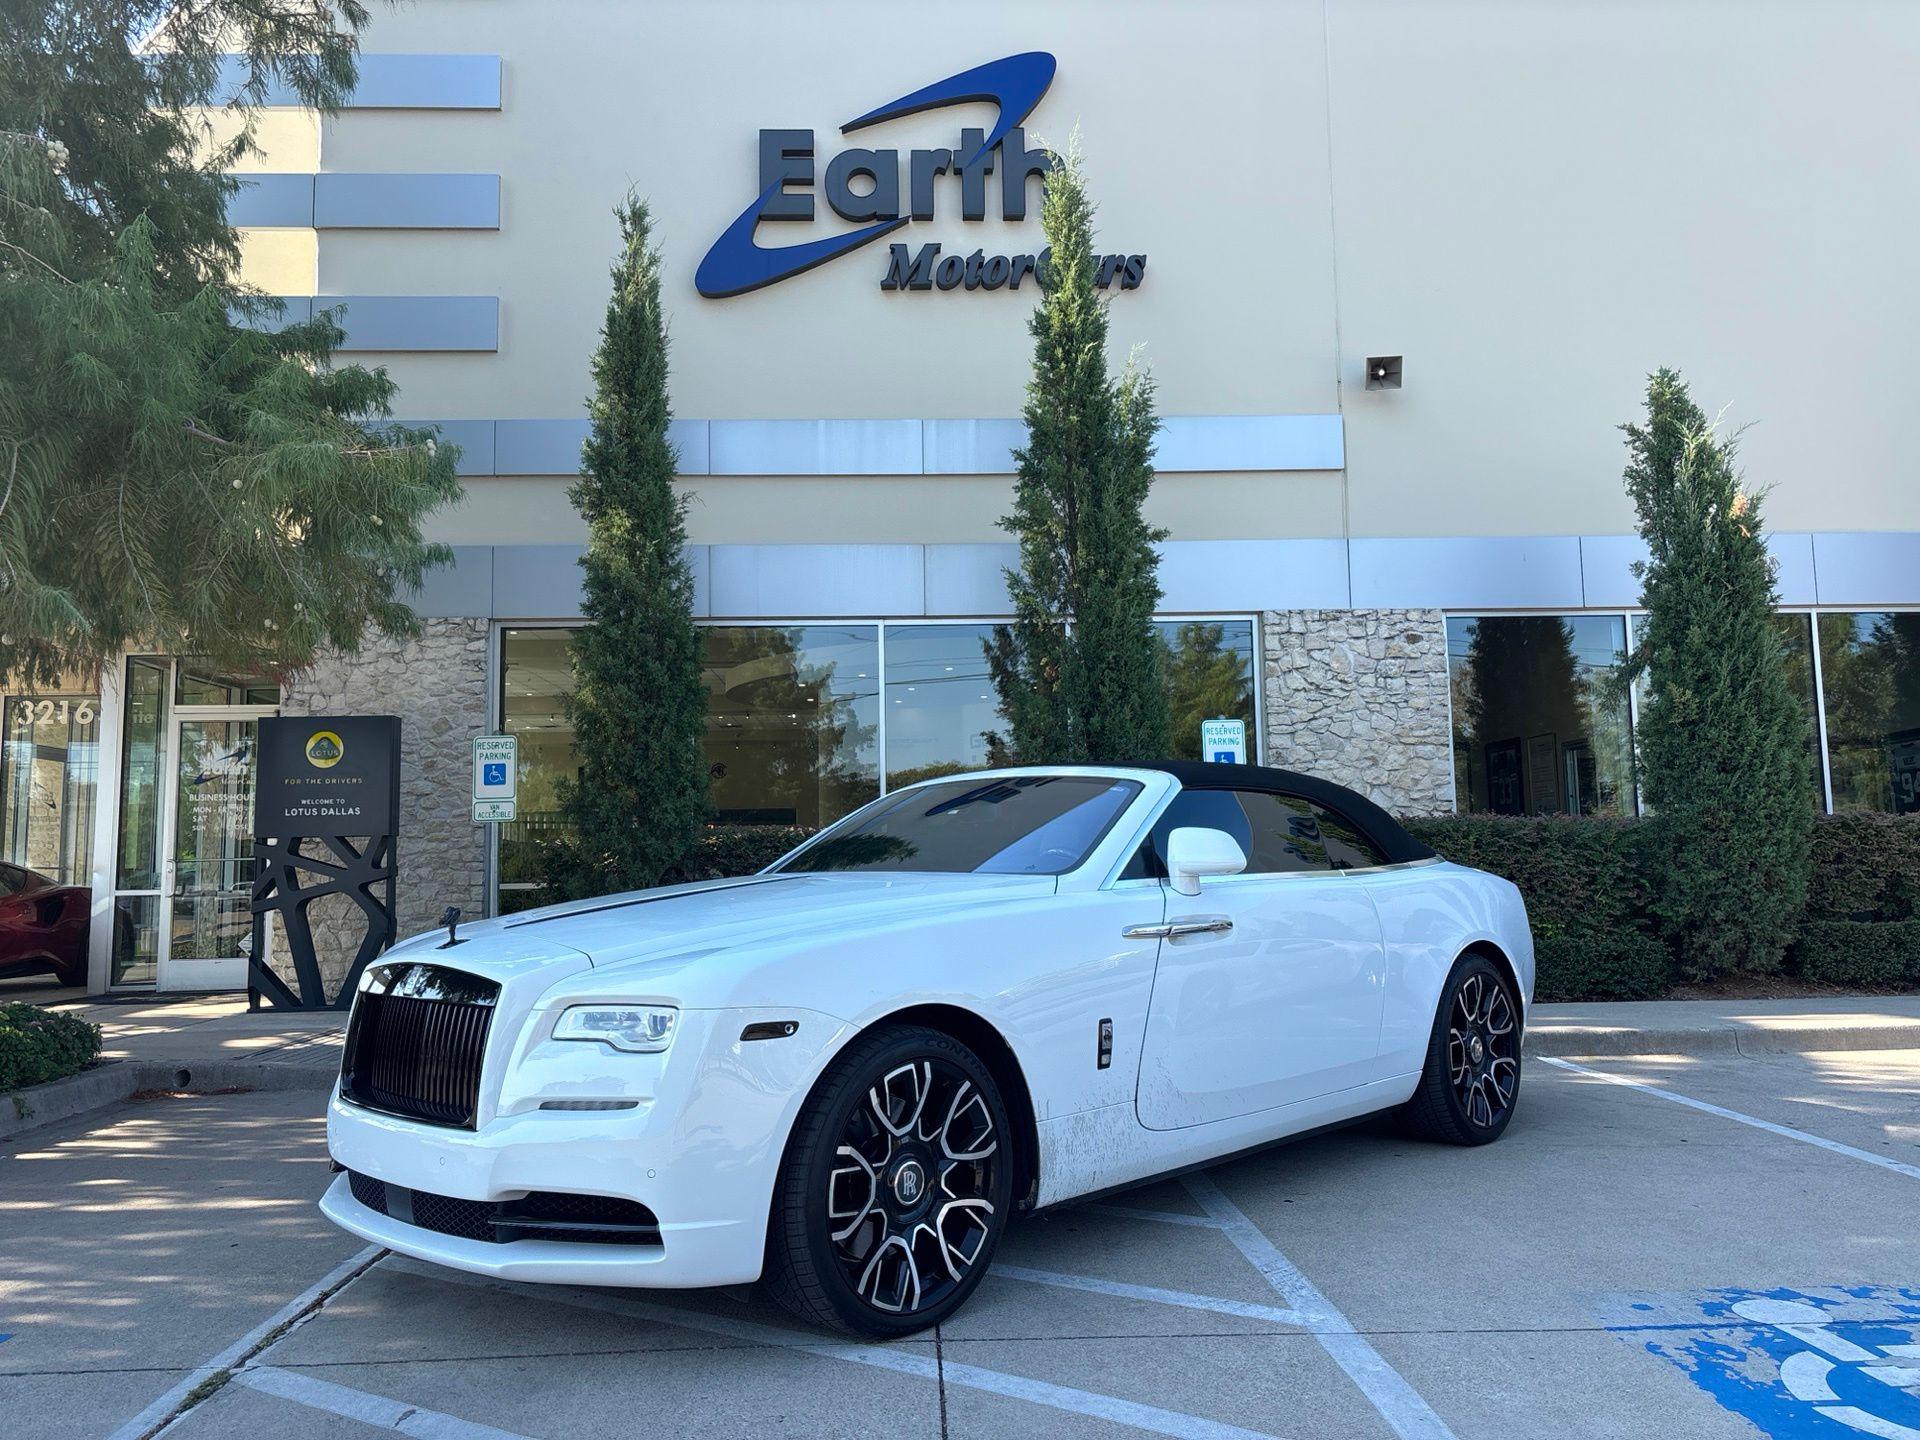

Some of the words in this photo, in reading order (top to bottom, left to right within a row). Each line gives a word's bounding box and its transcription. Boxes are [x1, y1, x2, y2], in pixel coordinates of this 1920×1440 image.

[759, 127, 1066, 223] Earth
[880, 243, 1148, 291] Motorrs
[18, 700, 95, 725] 3216
[1205, 727, 1241, 736] RESERVED
[477, 741, 515, 750] RESERVED
[1208, 737, 1240, 746] PARKING
[479, 752, 512, 760] PARKING
[189, 793, 228, 801] BUSINESS
[284, 807, 318, 817] LOTUS
[321, 807, 361, 816] DALLAS
[478, 811, 512, 819] ACCESSIBLE
